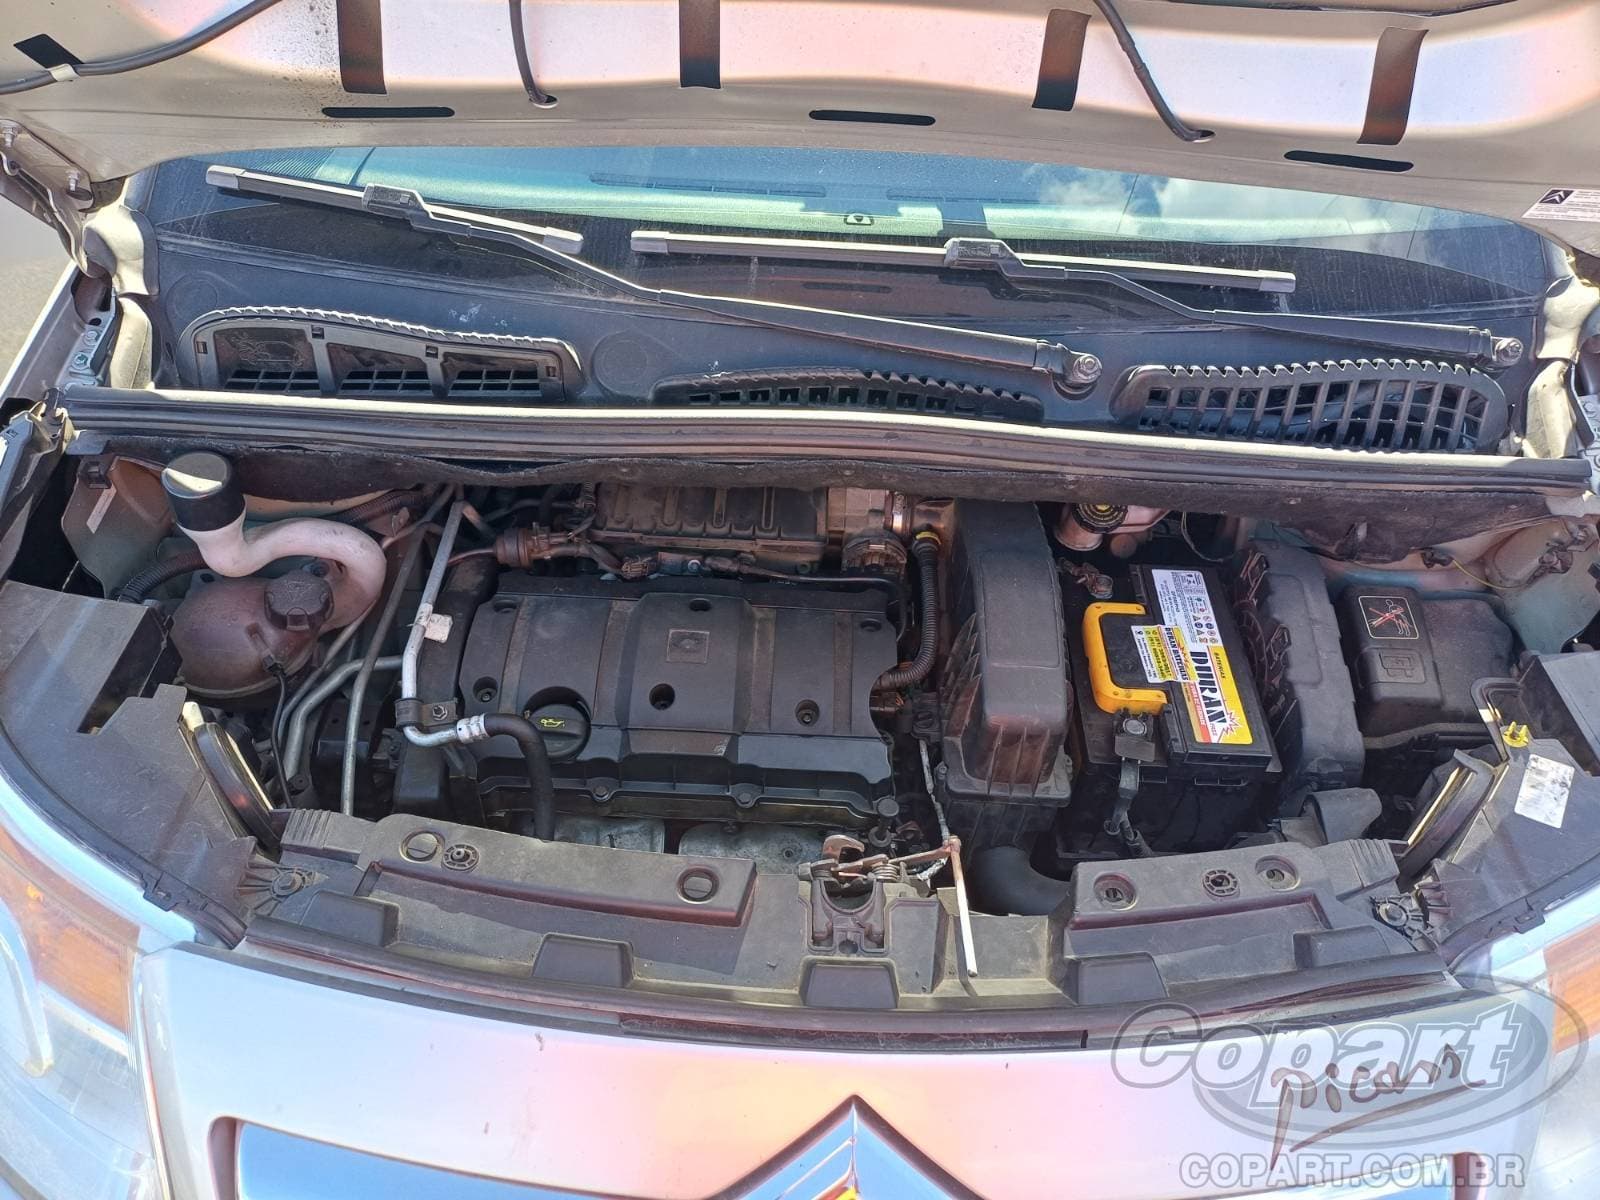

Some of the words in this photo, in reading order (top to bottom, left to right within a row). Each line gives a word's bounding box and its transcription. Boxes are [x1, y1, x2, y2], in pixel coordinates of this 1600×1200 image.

[1165, 627, 1178, 649] DURAN
[1172, 649, 1189, 681] BATERIAS
[1213, 652, 1226, 679] BATERIAS
[1190, 651, 1227, 723] DURAN
